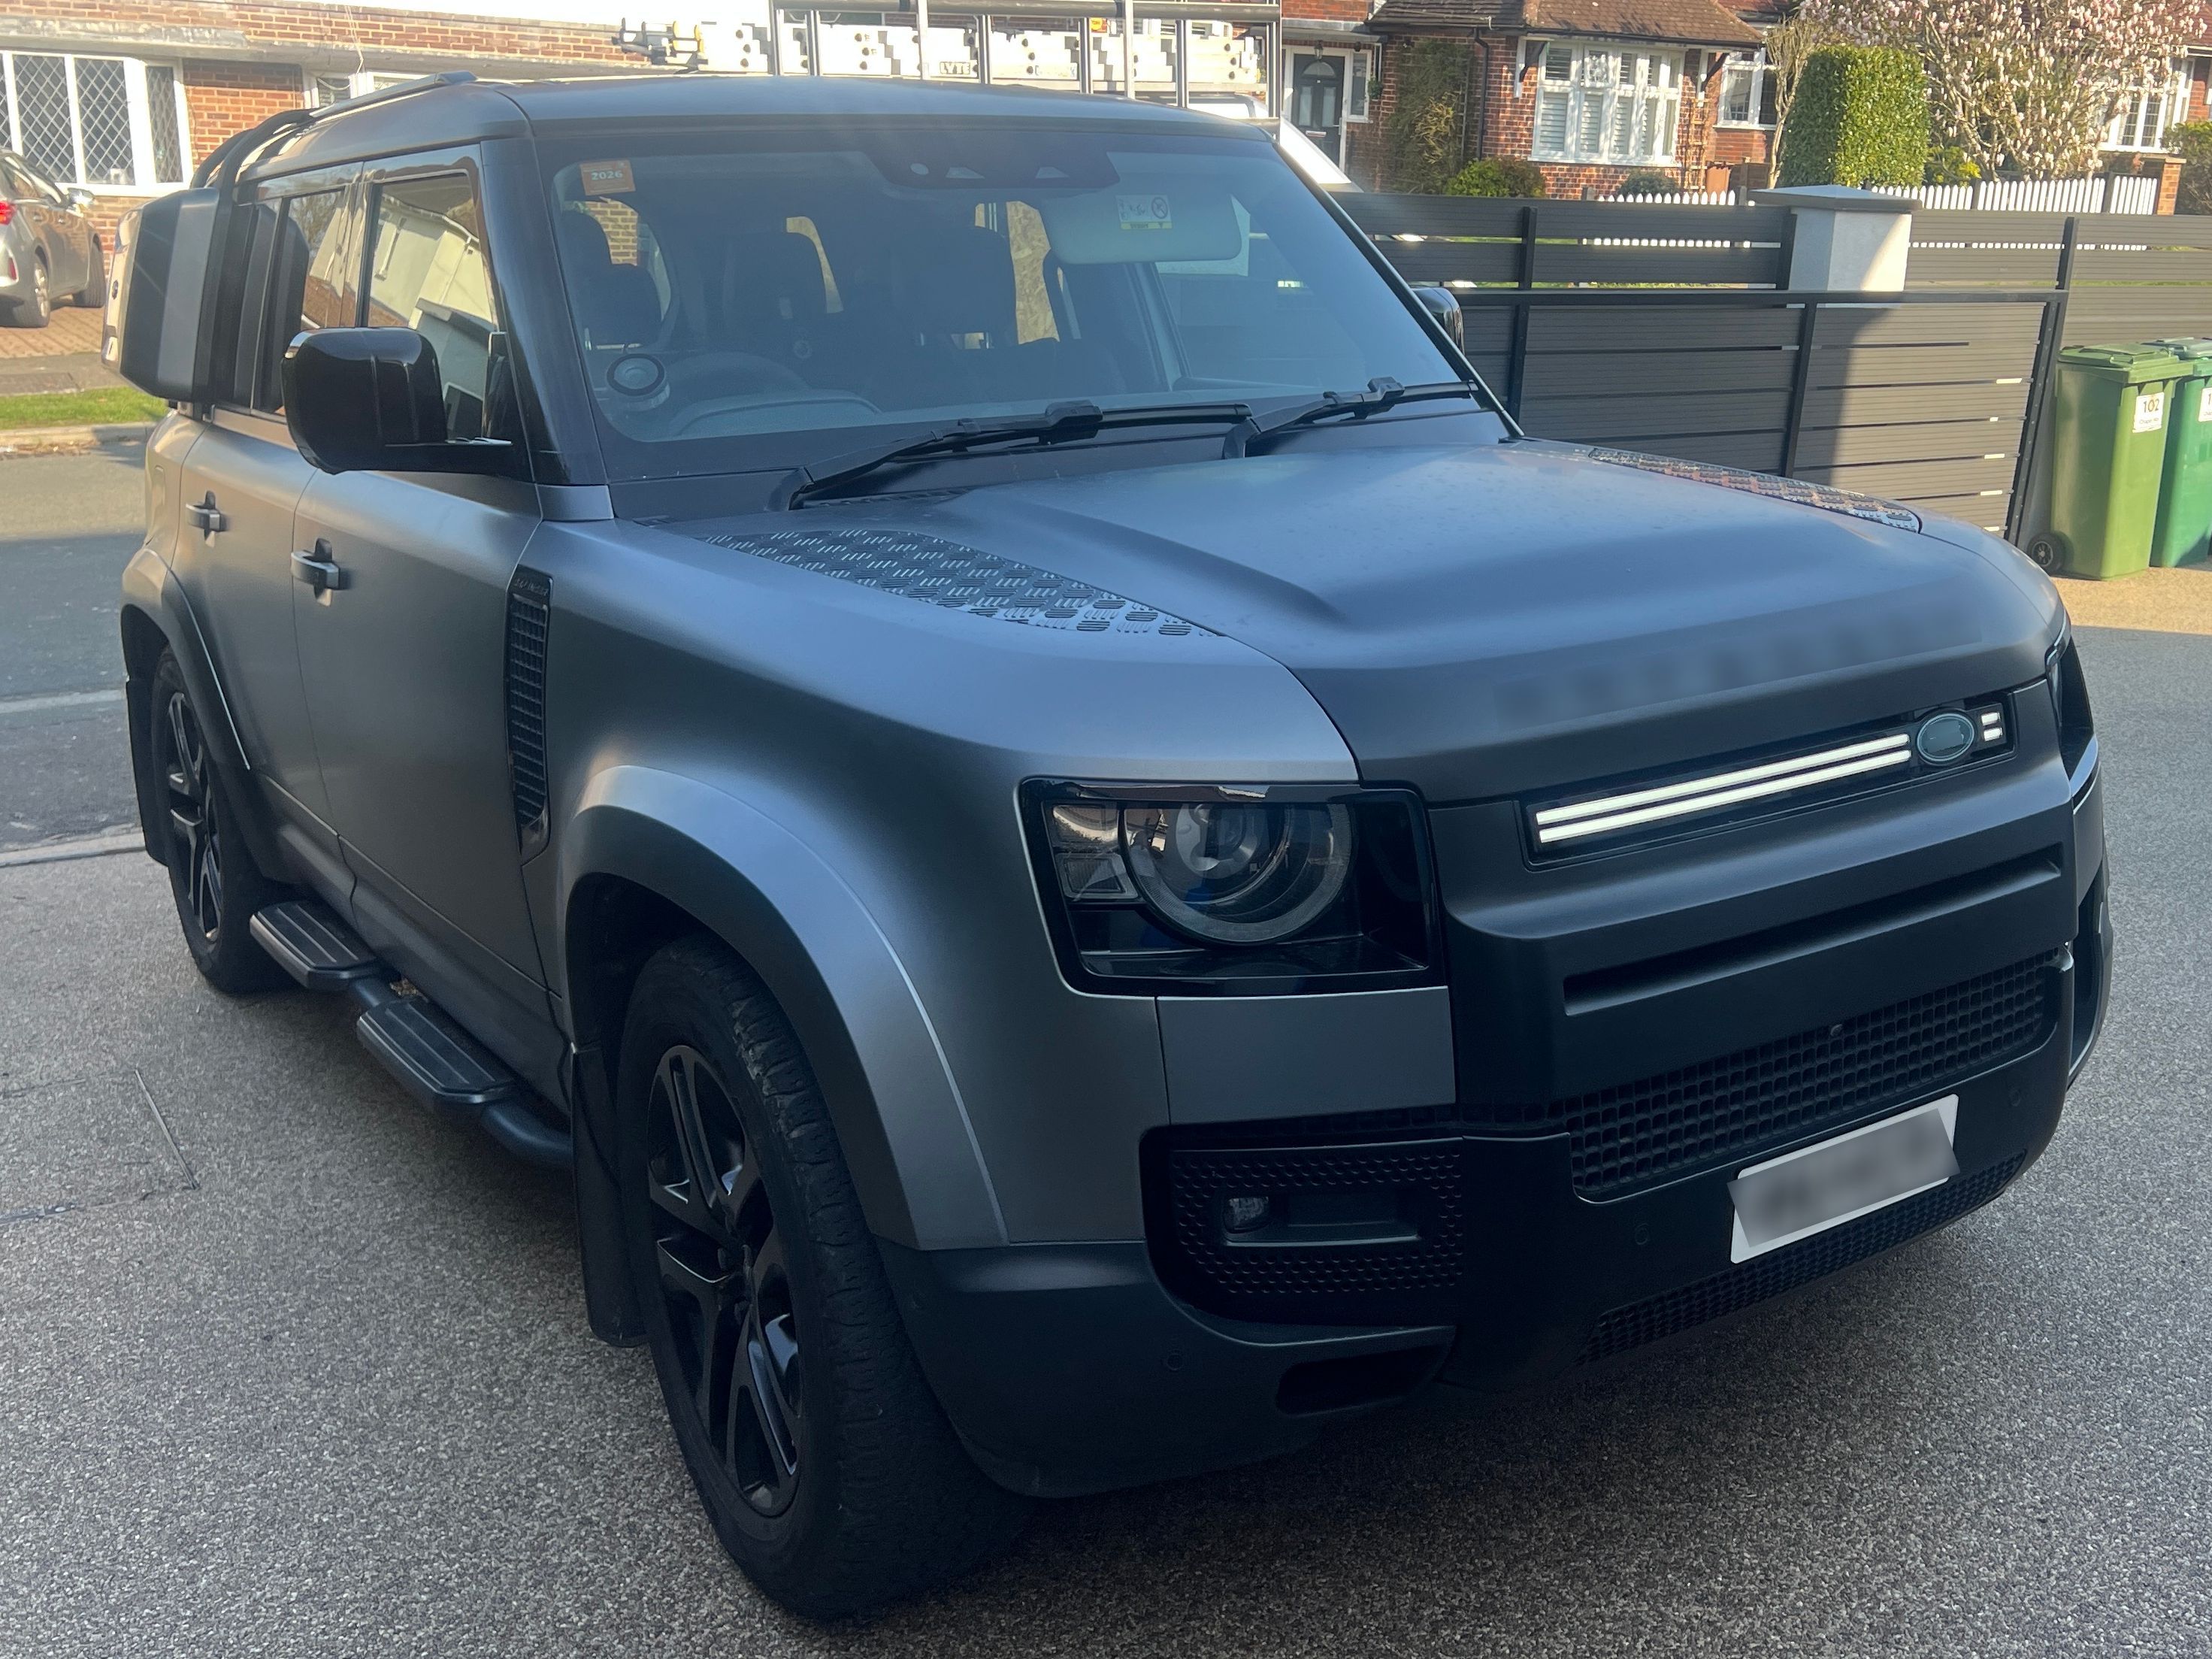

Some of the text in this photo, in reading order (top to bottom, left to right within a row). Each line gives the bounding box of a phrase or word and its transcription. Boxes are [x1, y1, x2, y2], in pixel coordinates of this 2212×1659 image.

[940, 62, 970, 74] LYTE
[591, 170, 623, 180] 2026
[2143, 398, 2160, 413] 102
